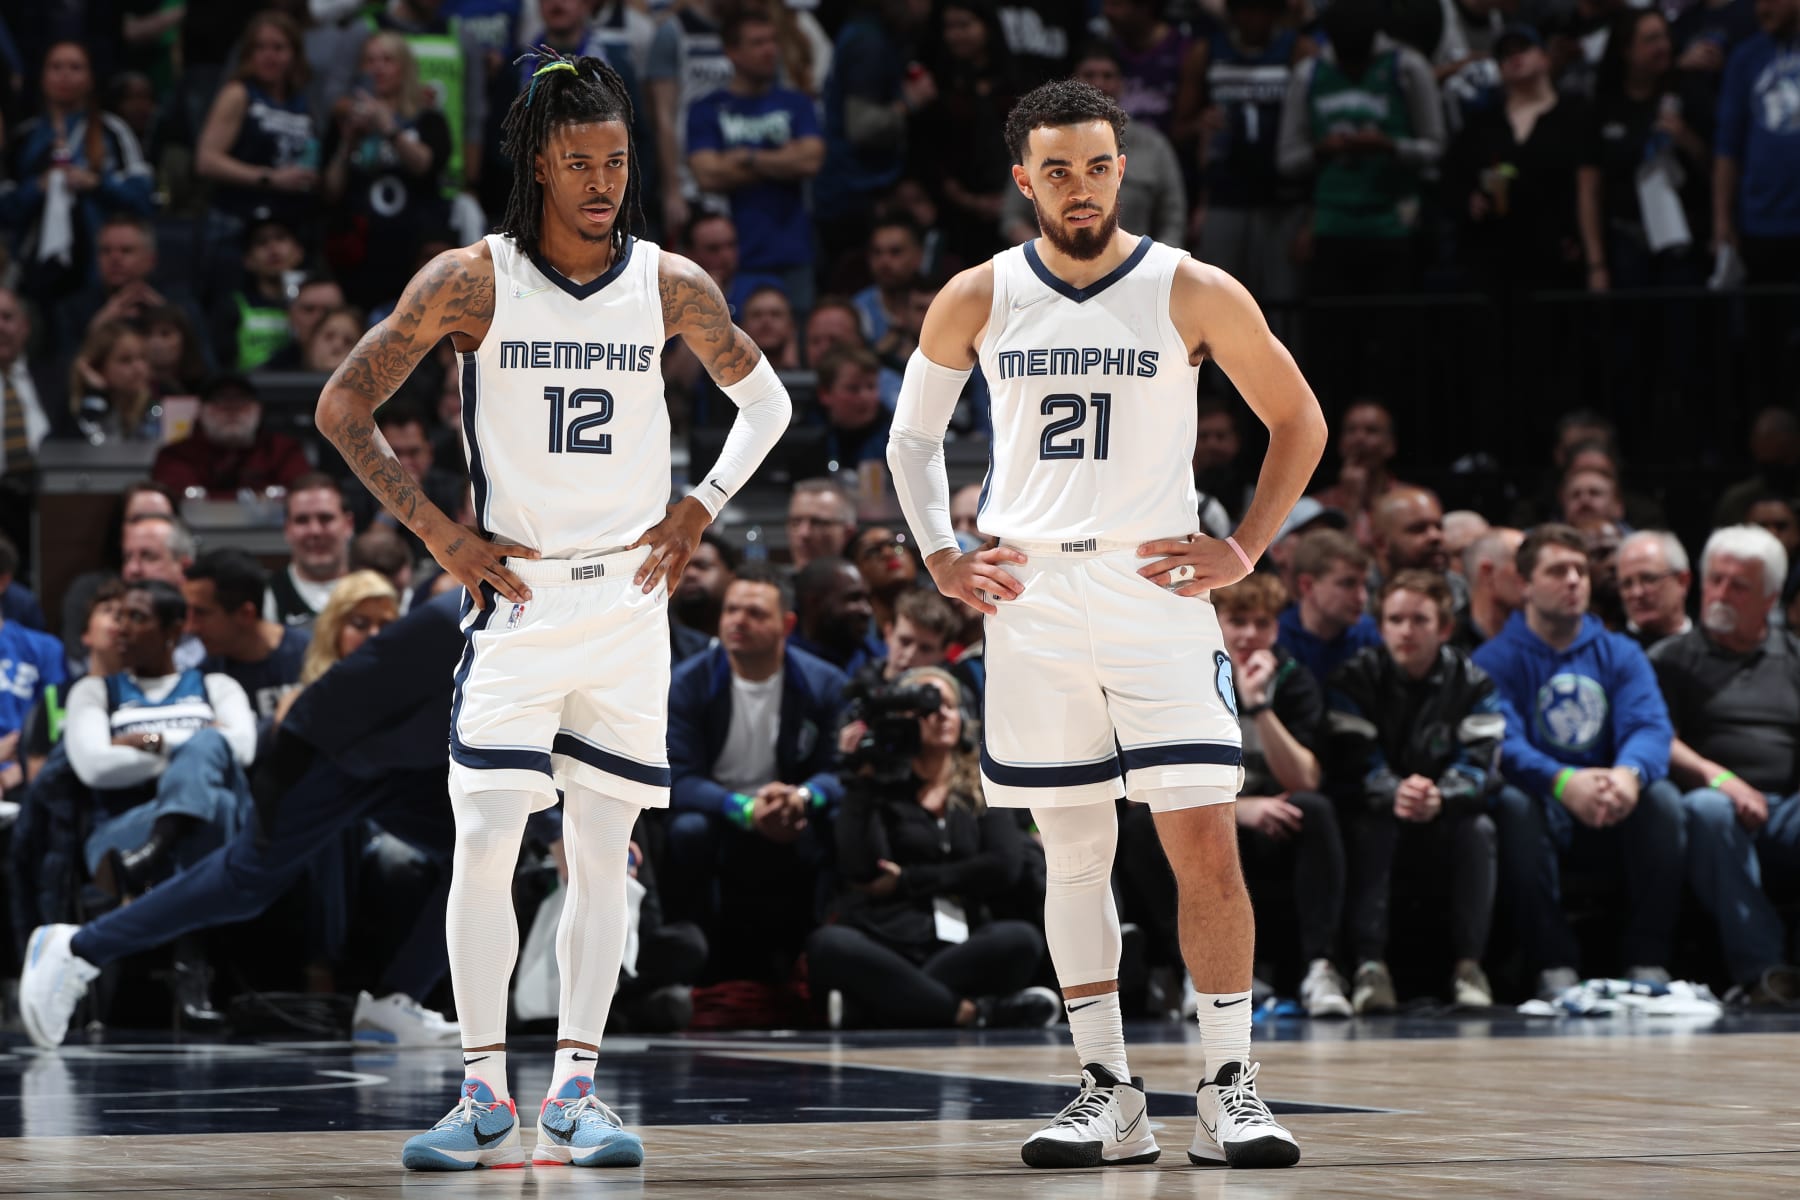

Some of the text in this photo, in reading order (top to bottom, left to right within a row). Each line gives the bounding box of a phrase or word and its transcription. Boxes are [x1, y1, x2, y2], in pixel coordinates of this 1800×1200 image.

[500, 341, 655, 373] MEMPHIS
[998, 348, 1160, 380] MEMPHIS
[543, 386, 615, 455] 12
[1039, 392, 1112, 461] 21
